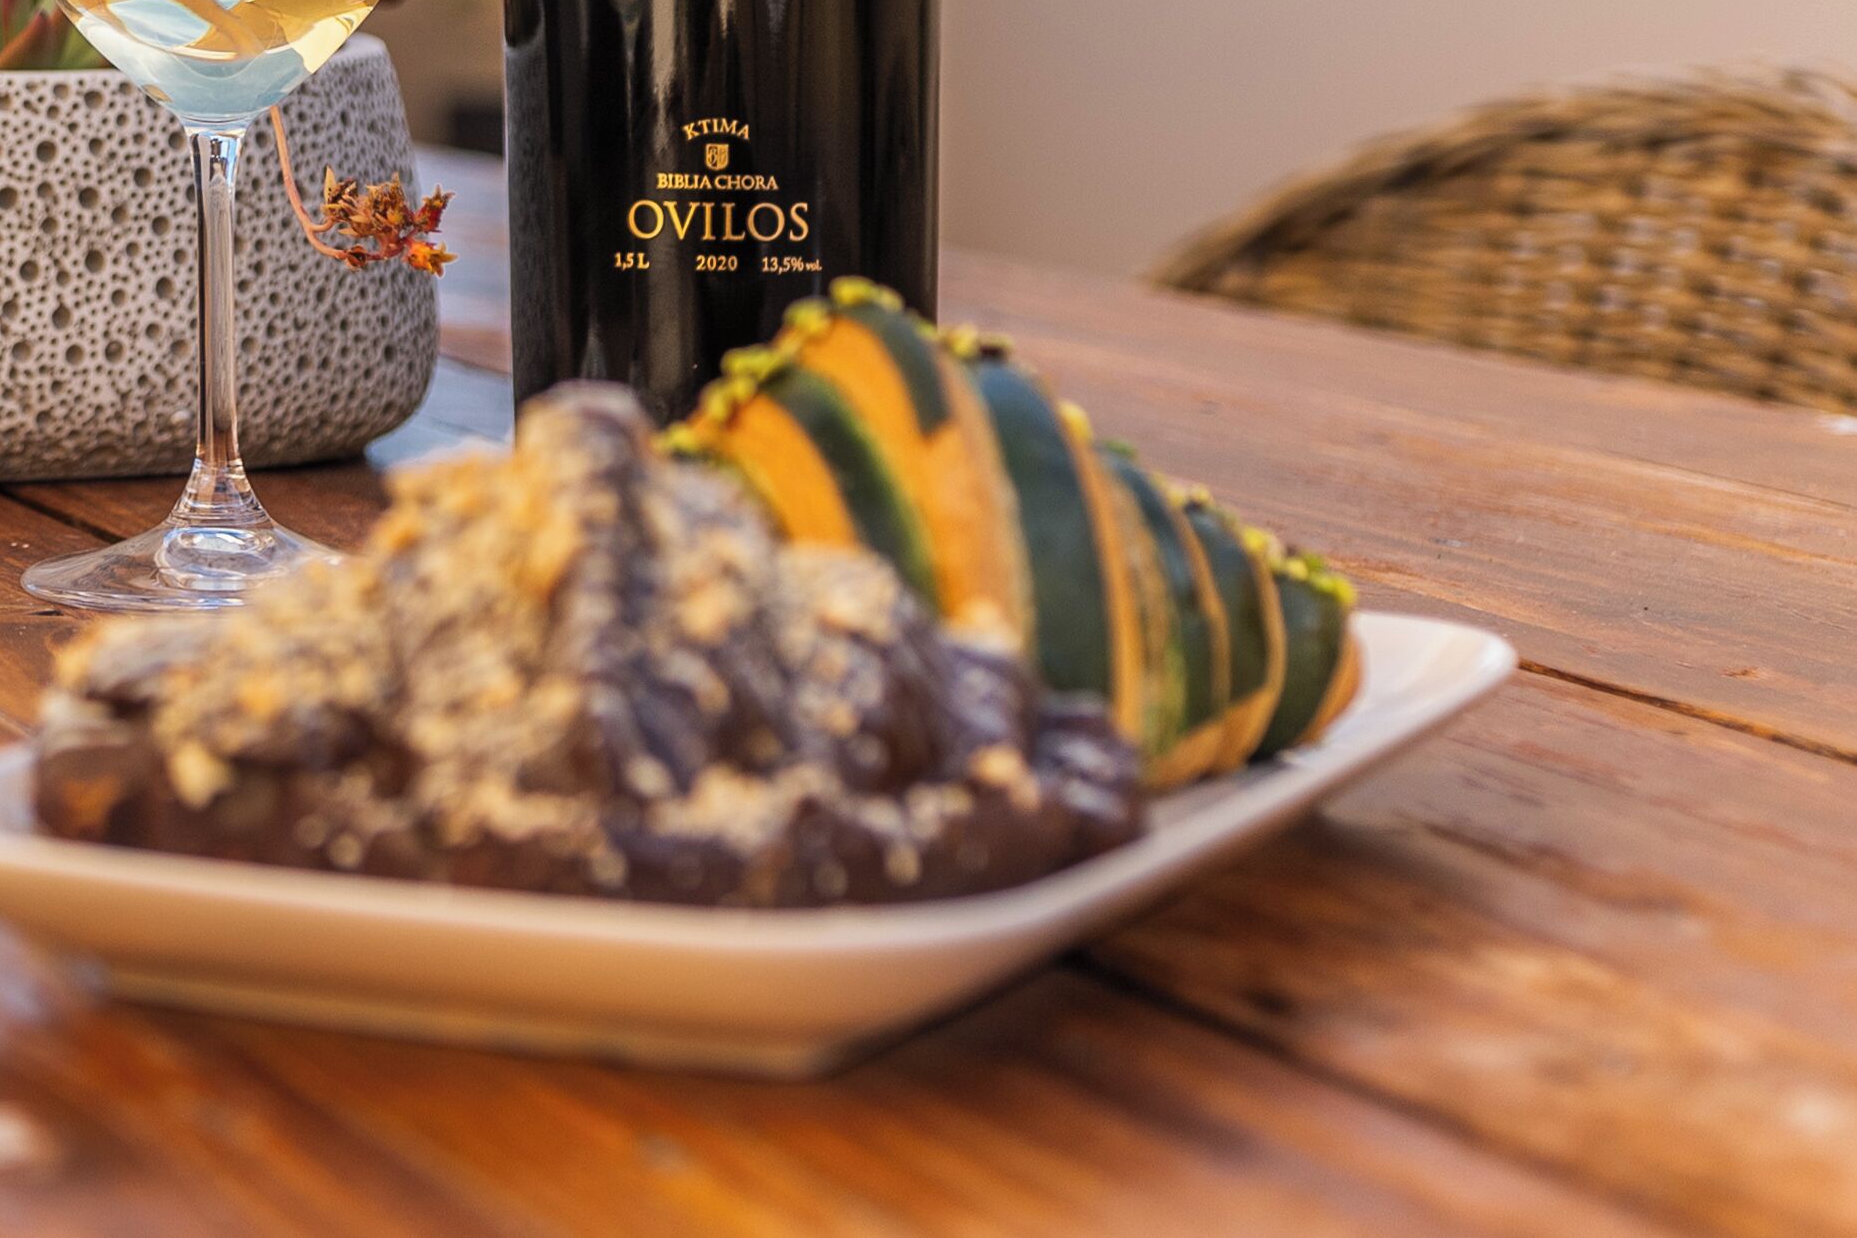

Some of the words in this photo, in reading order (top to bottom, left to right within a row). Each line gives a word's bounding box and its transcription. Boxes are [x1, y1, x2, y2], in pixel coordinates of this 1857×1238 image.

[683, 118, 750, 141] KTIMA
[656, 173, 712, 190] BIBLIA
[714, 175, 779, 191] CHORA
[627, 199, 810, 242] OVILOS
[614, 252, 634, 270] 1,5
[637, 252, 650, 269] L
[696, 255, 738, 271] 2020
[762, 257, 804, 275] 13,5%
